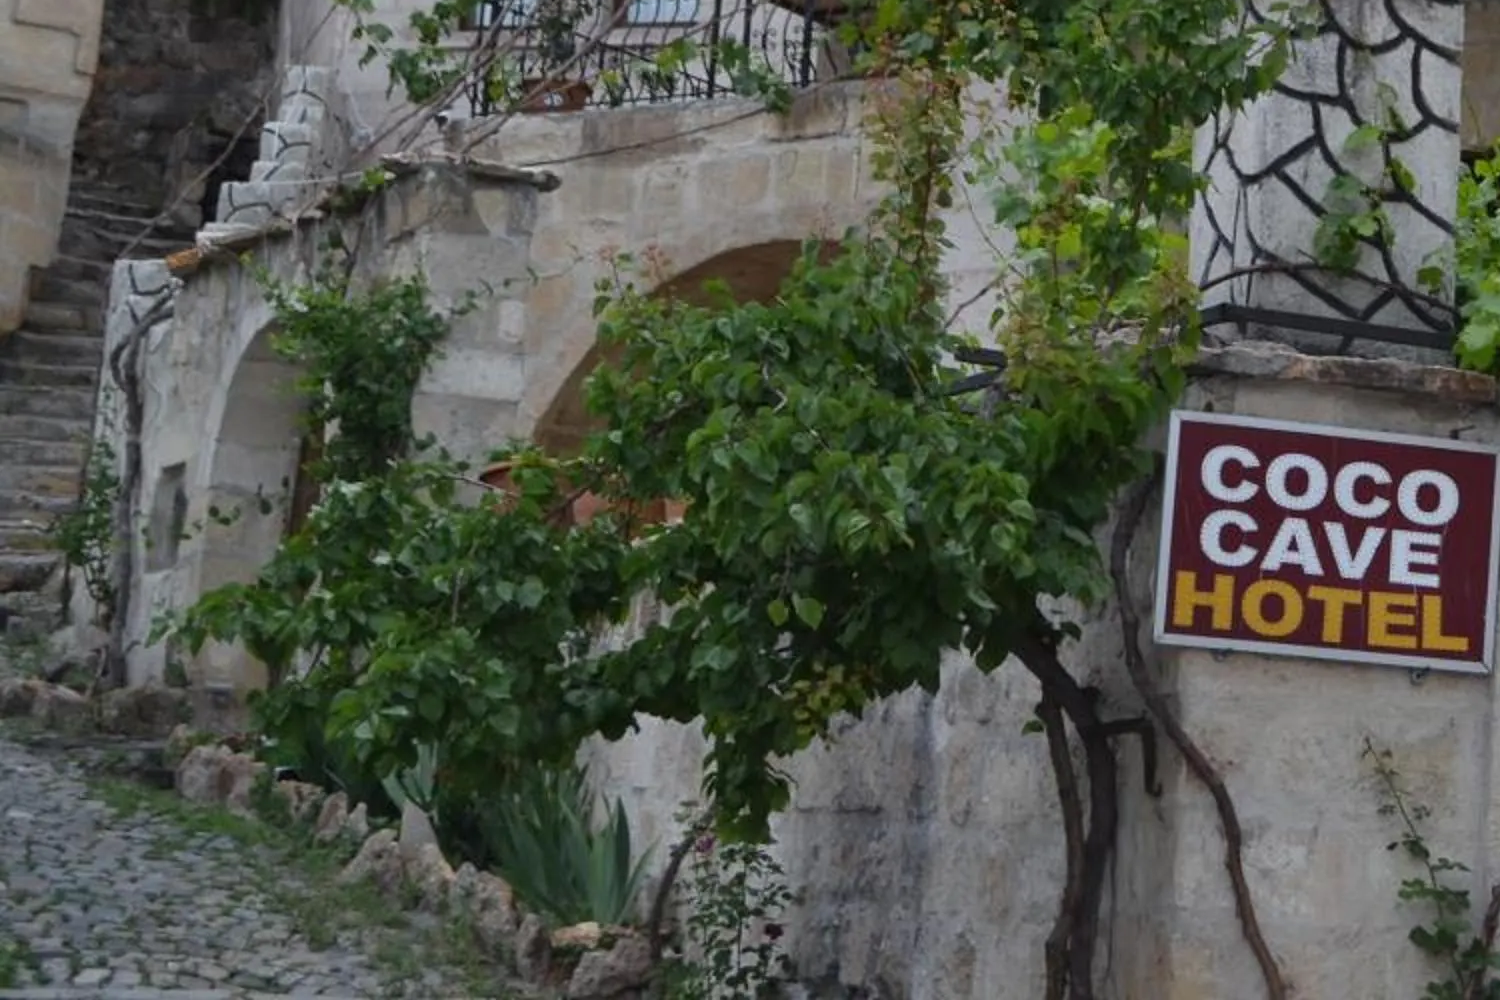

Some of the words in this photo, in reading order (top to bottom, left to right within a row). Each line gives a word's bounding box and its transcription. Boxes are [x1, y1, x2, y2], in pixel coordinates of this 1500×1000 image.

[1200, 444, 1460, 526] COCO
[1199, 509, 1443, 589] CAVE
[1172, 570, 1470, 652] HOTEL
